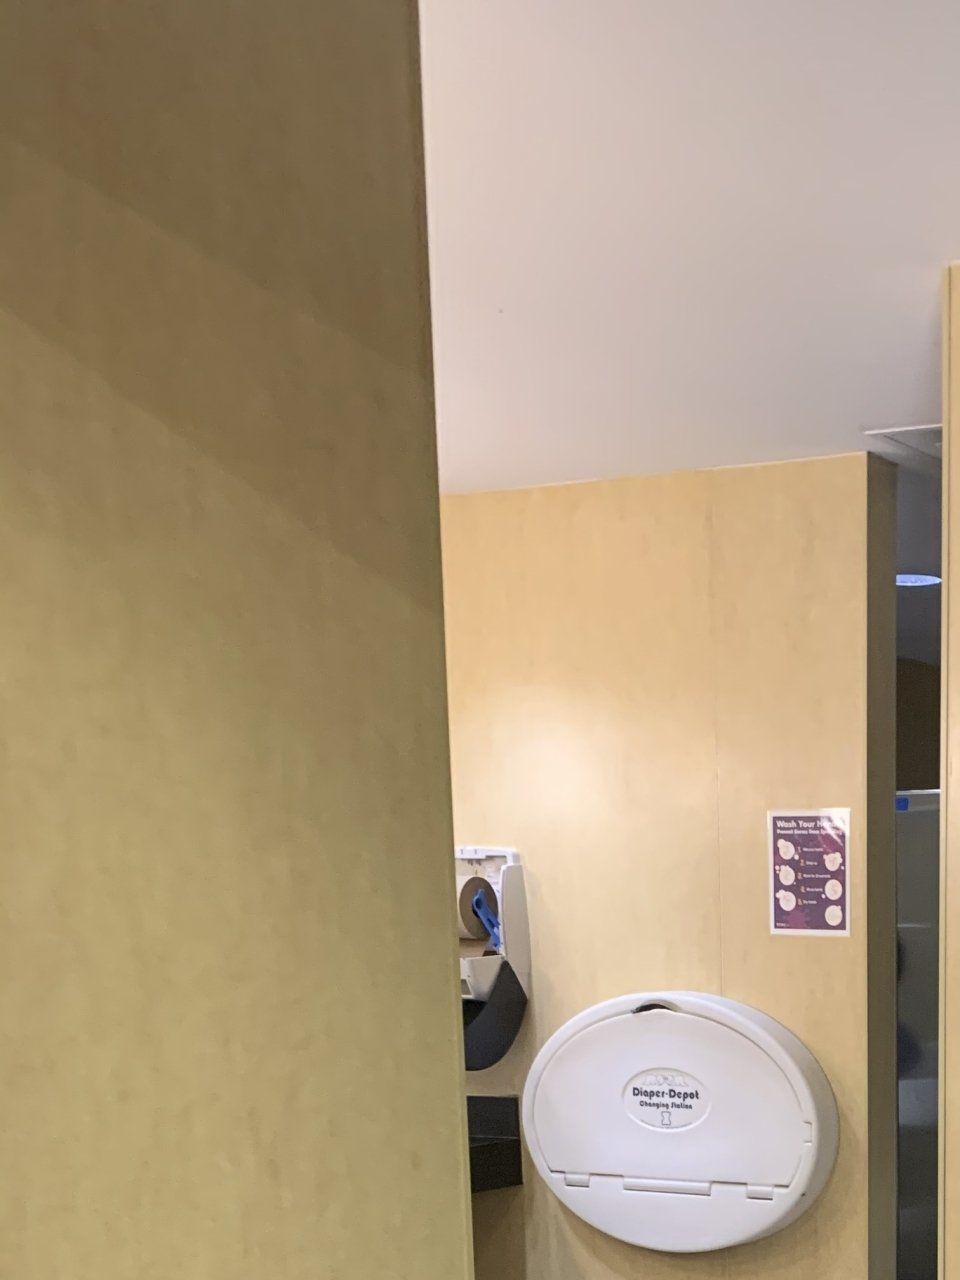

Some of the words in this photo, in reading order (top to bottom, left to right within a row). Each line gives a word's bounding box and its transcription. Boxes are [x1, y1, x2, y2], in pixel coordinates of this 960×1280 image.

[776, 820, 797, 828] Wash
[798, 820, 816, 828] Your
[639, 1100, 670, 1110] Changing
[671, 1102, 693, 1110] Station
